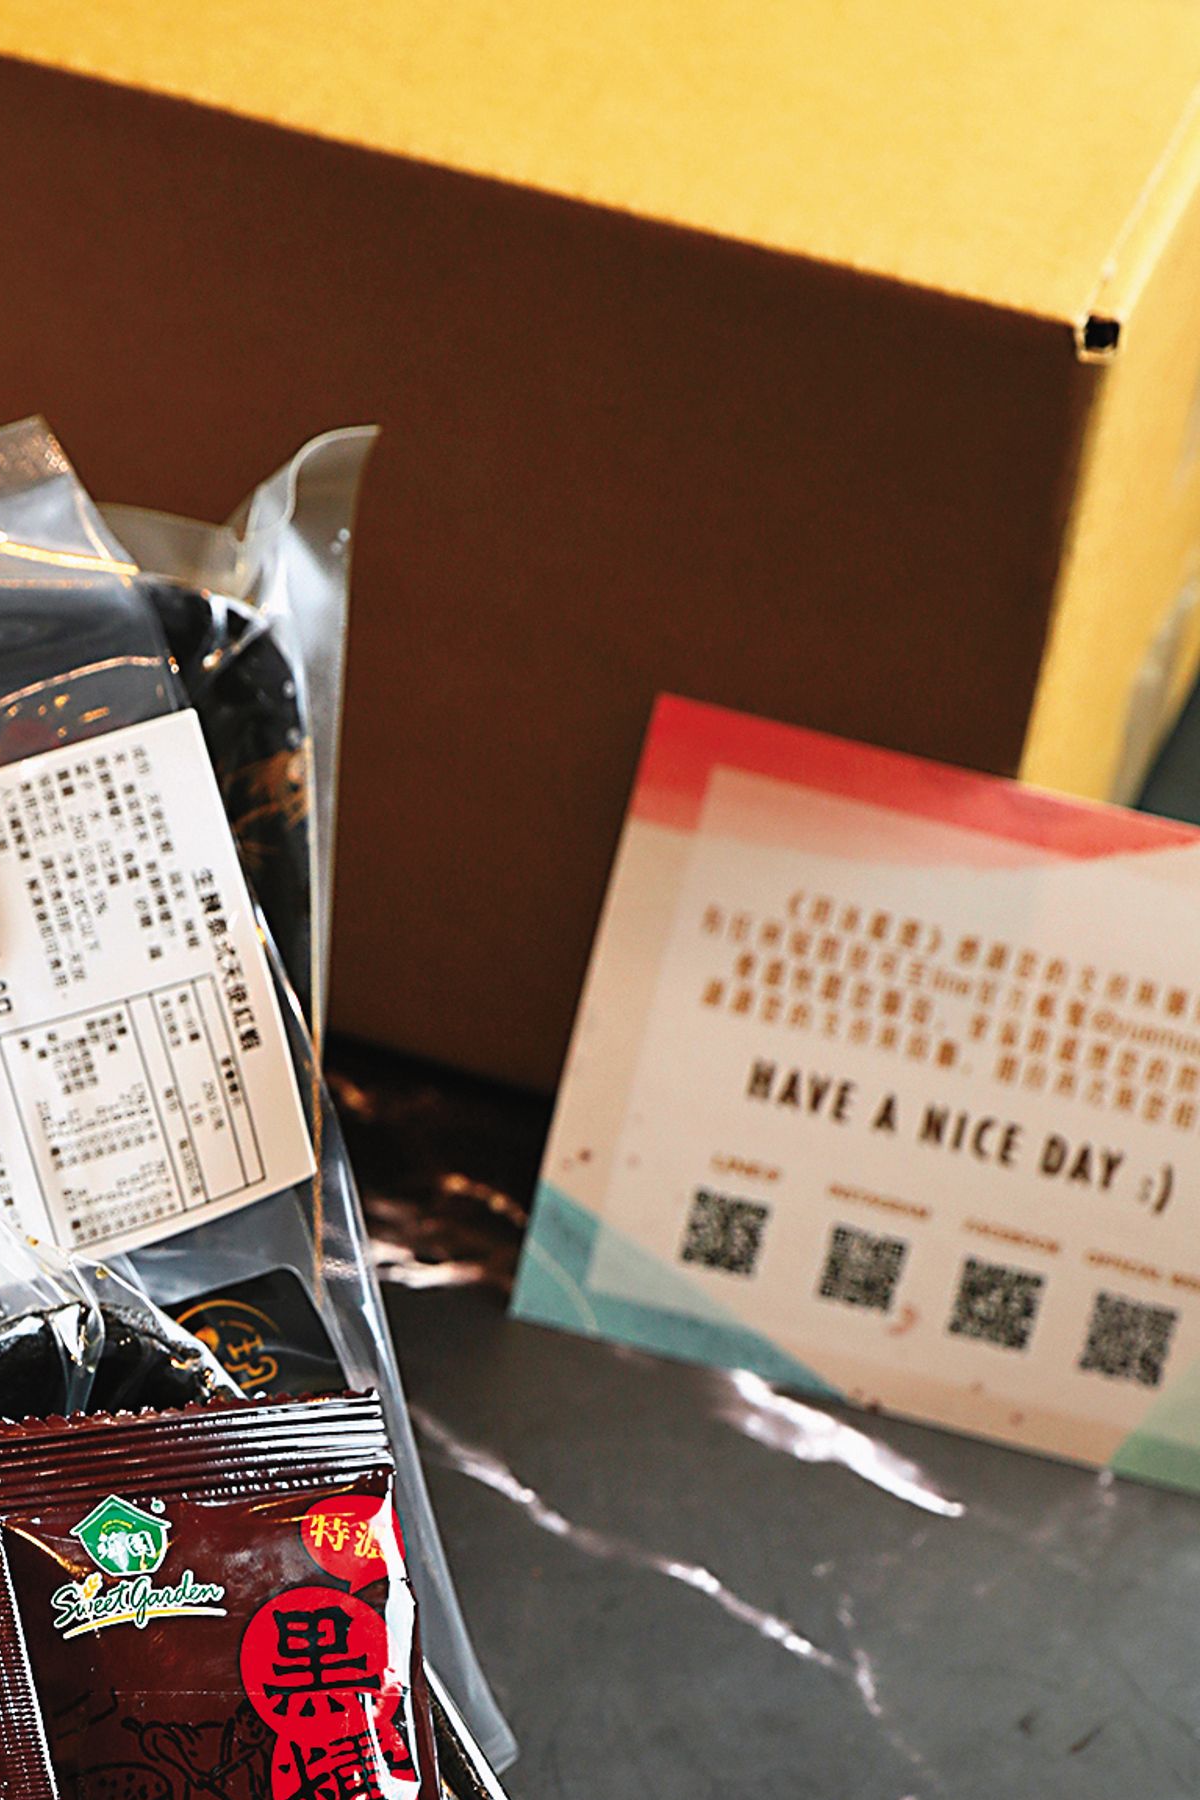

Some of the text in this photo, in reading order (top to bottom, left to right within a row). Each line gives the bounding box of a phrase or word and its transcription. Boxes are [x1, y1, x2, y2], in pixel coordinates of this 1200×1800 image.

[748, 1057, 856, 1124] HAVE
[872, 1095, 898, 1132] A
[919, 1104, 1023, 1166] NICE
[1039, 1134, 1123, 1190] DAY
[53, 1570, 224, 1627] Sweet Garden
